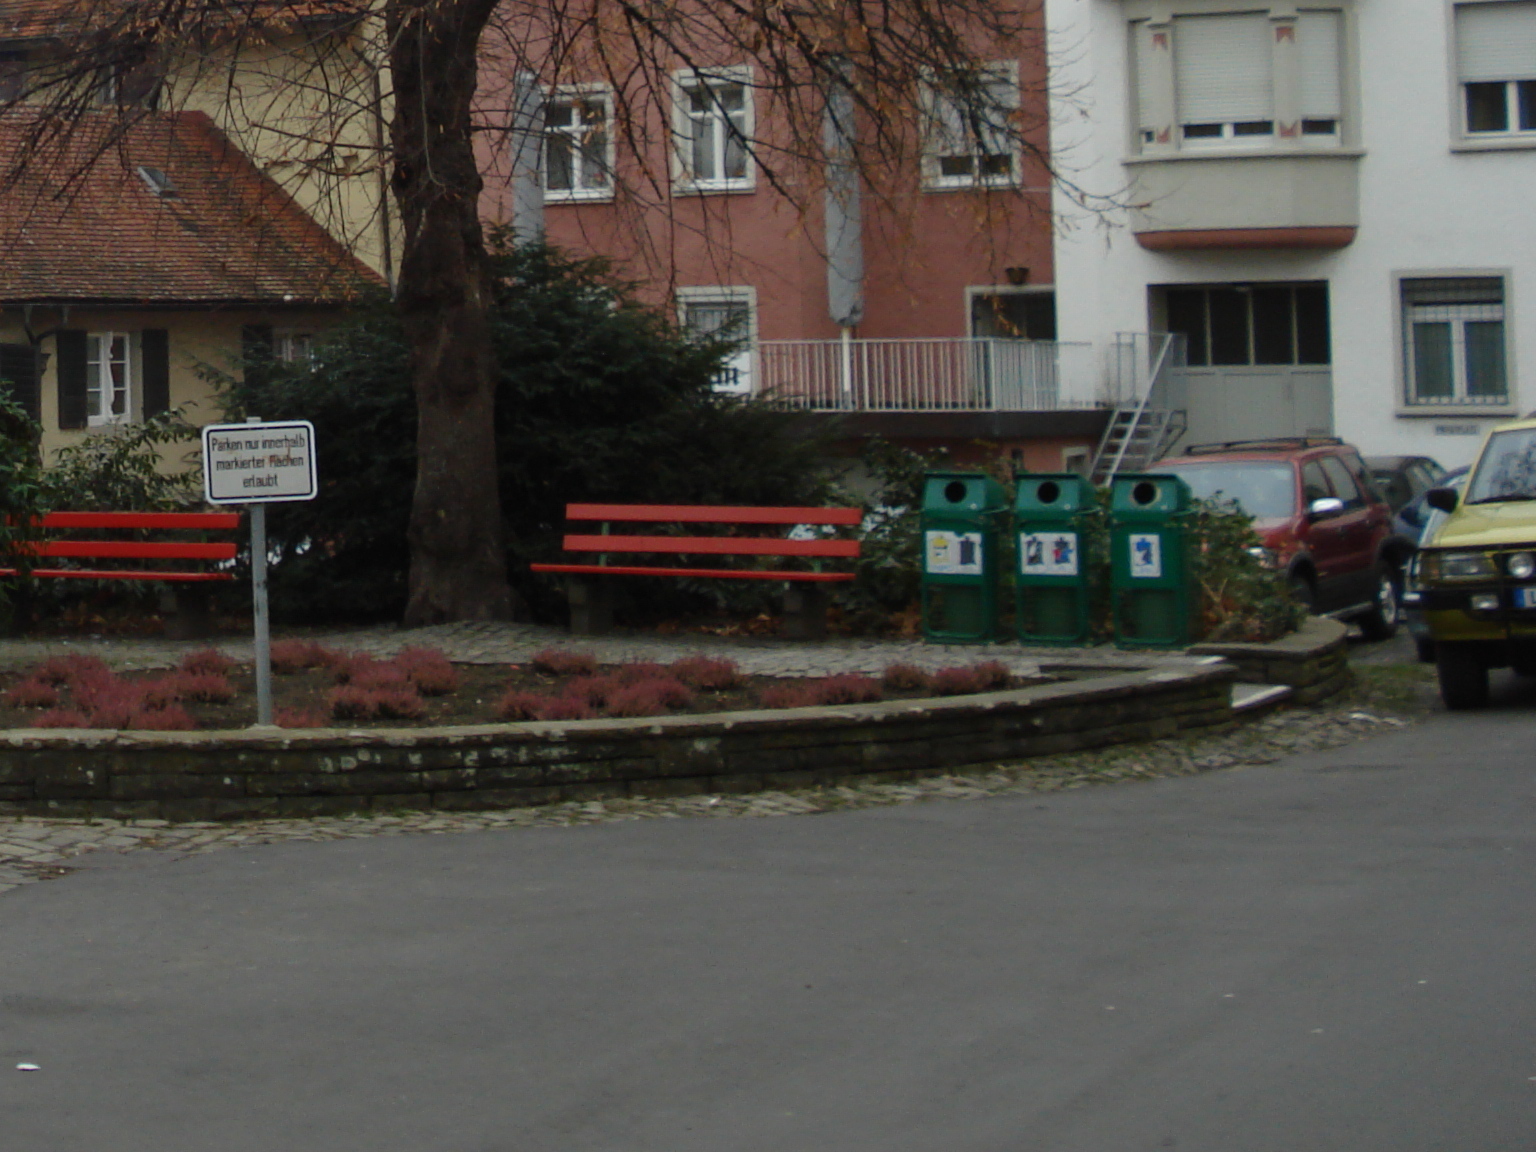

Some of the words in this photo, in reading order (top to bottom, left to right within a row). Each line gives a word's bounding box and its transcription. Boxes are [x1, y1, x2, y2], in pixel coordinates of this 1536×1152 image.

[211, 437, 243, 451] Parken
[244, 439, 260, 450] nur
[262, 433, 306, 449] innerhalb
[216, 456, 265, 471] markierter
[243, 474, 278, 488] erlaubt
